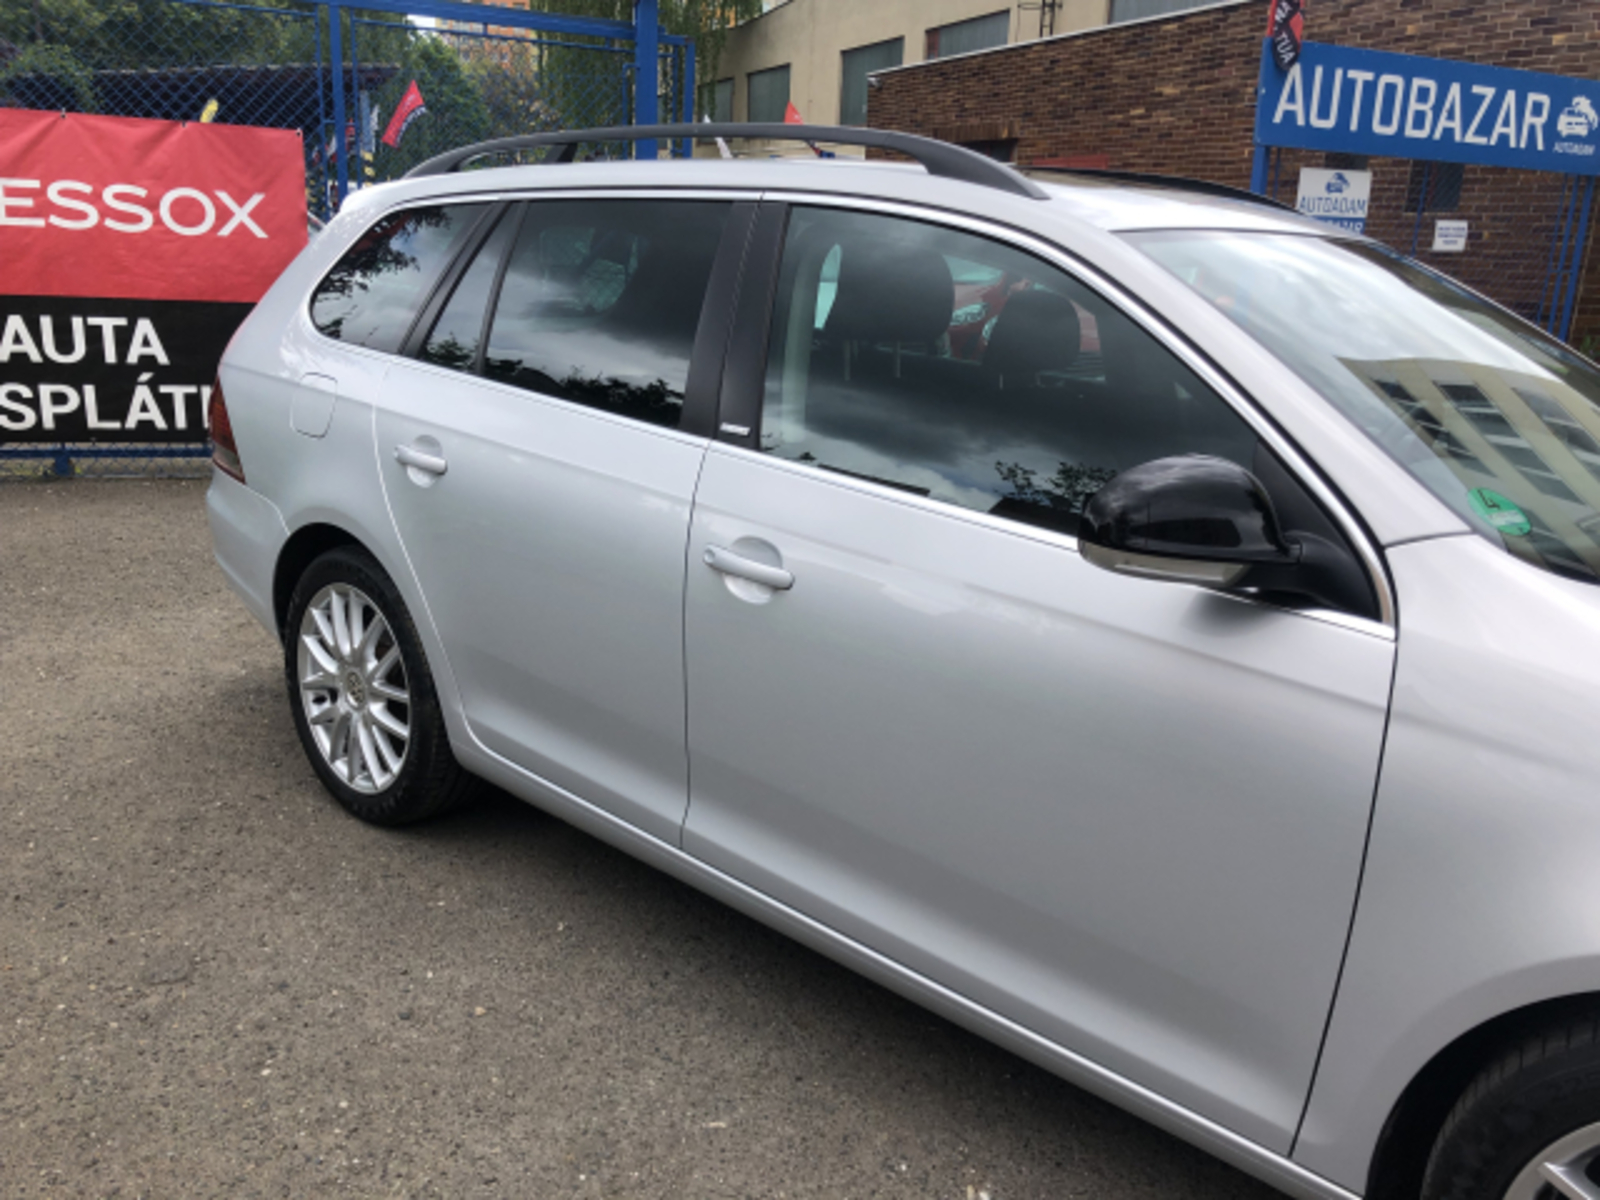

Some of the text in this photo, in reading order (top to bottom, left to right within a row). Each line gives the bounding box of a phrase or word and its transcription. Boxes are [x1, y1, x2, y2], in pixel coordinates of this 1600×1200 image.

[1272, 62, 1550, 151] AUTOBAZAR
[0, 177, 268, 238] ESSOX
[0, 314, 171, 366] AUTA
